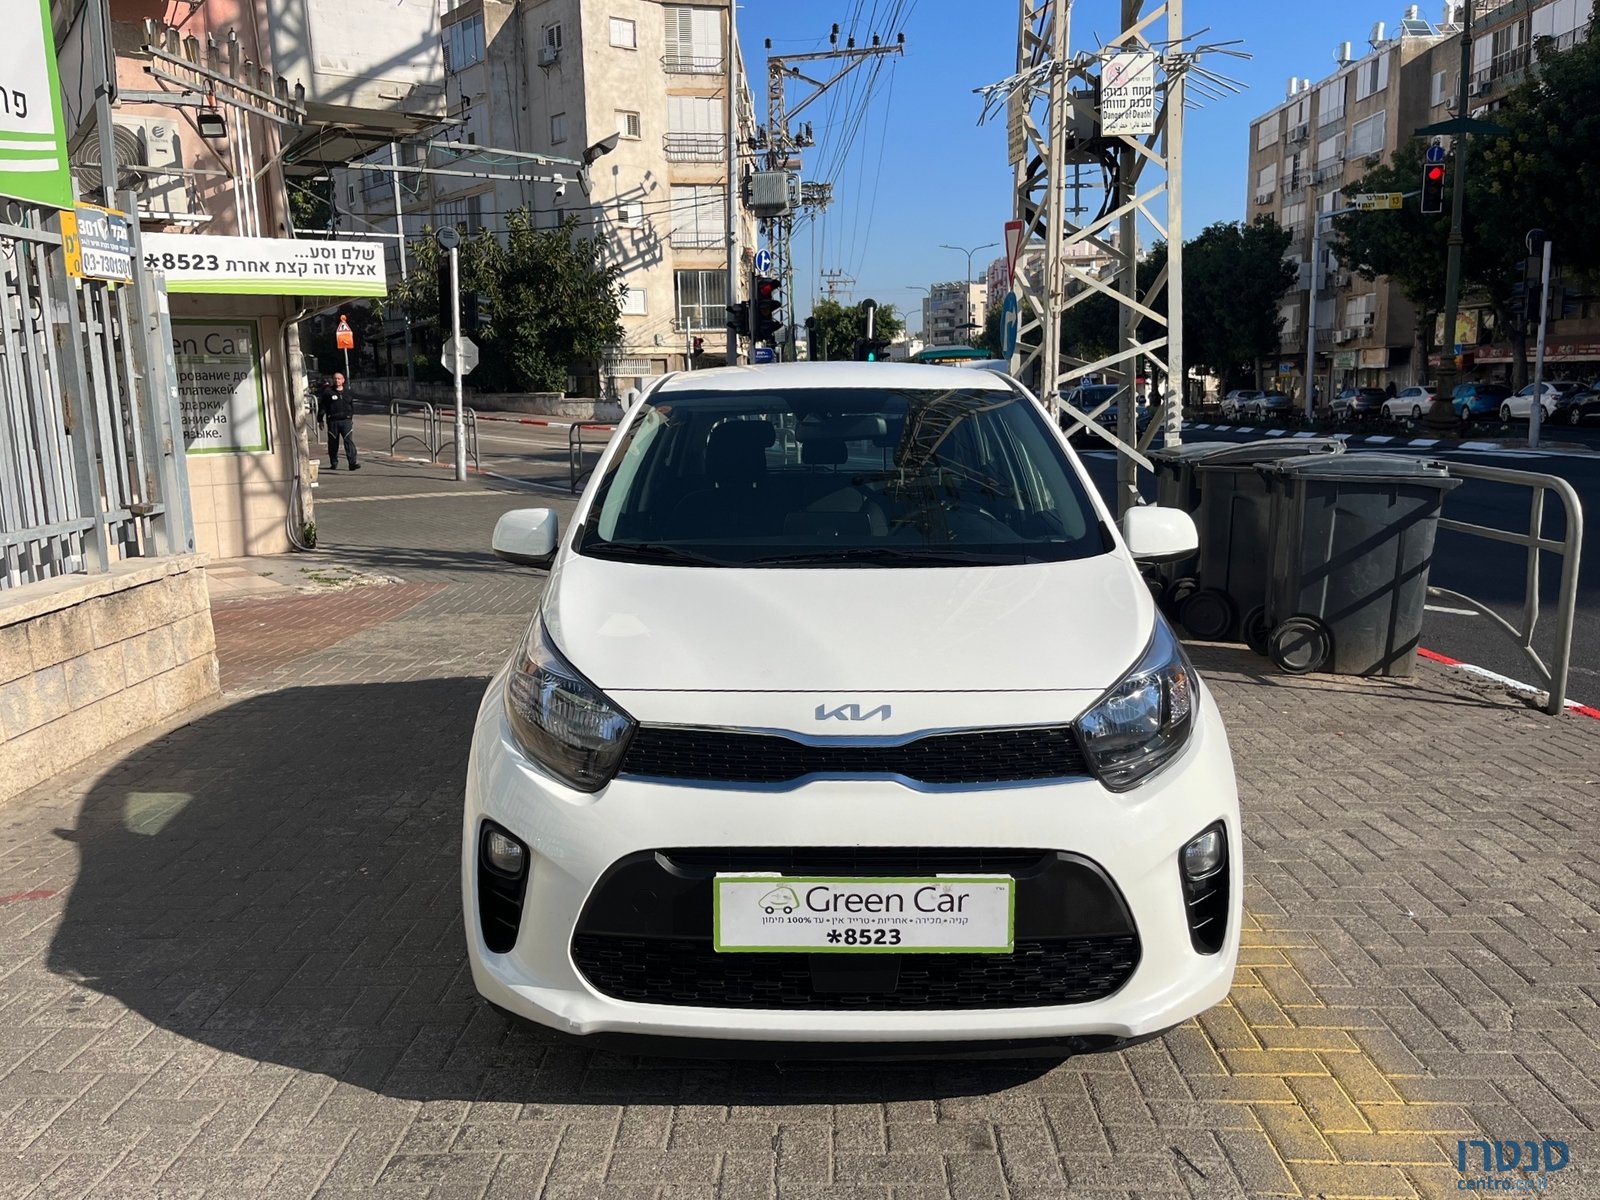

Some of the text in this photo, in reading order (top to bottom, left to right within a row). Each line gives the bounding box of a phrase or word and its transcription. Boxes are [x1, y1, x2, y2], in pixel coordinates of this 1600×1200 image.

[78, 219, 99, 237] 301
[342, 246, 375, 261] שלם
[83, 253, 132, 276] 03-7301301
[225, 259, 270, 273] אחרת
[275, 261, 308, 277] קצת
[313, 262, 330, 275] זה
[335, 261, 376, 275] אצלנו
[233, 370, 248, 383] до
[213, 416, 227, 424] на
[183, 428, 222, 440] языке.
[815, 704, 891, 721] KIA
[805, 886, 970, 913] Green Car
[787, 916, 812, 924] 100%
